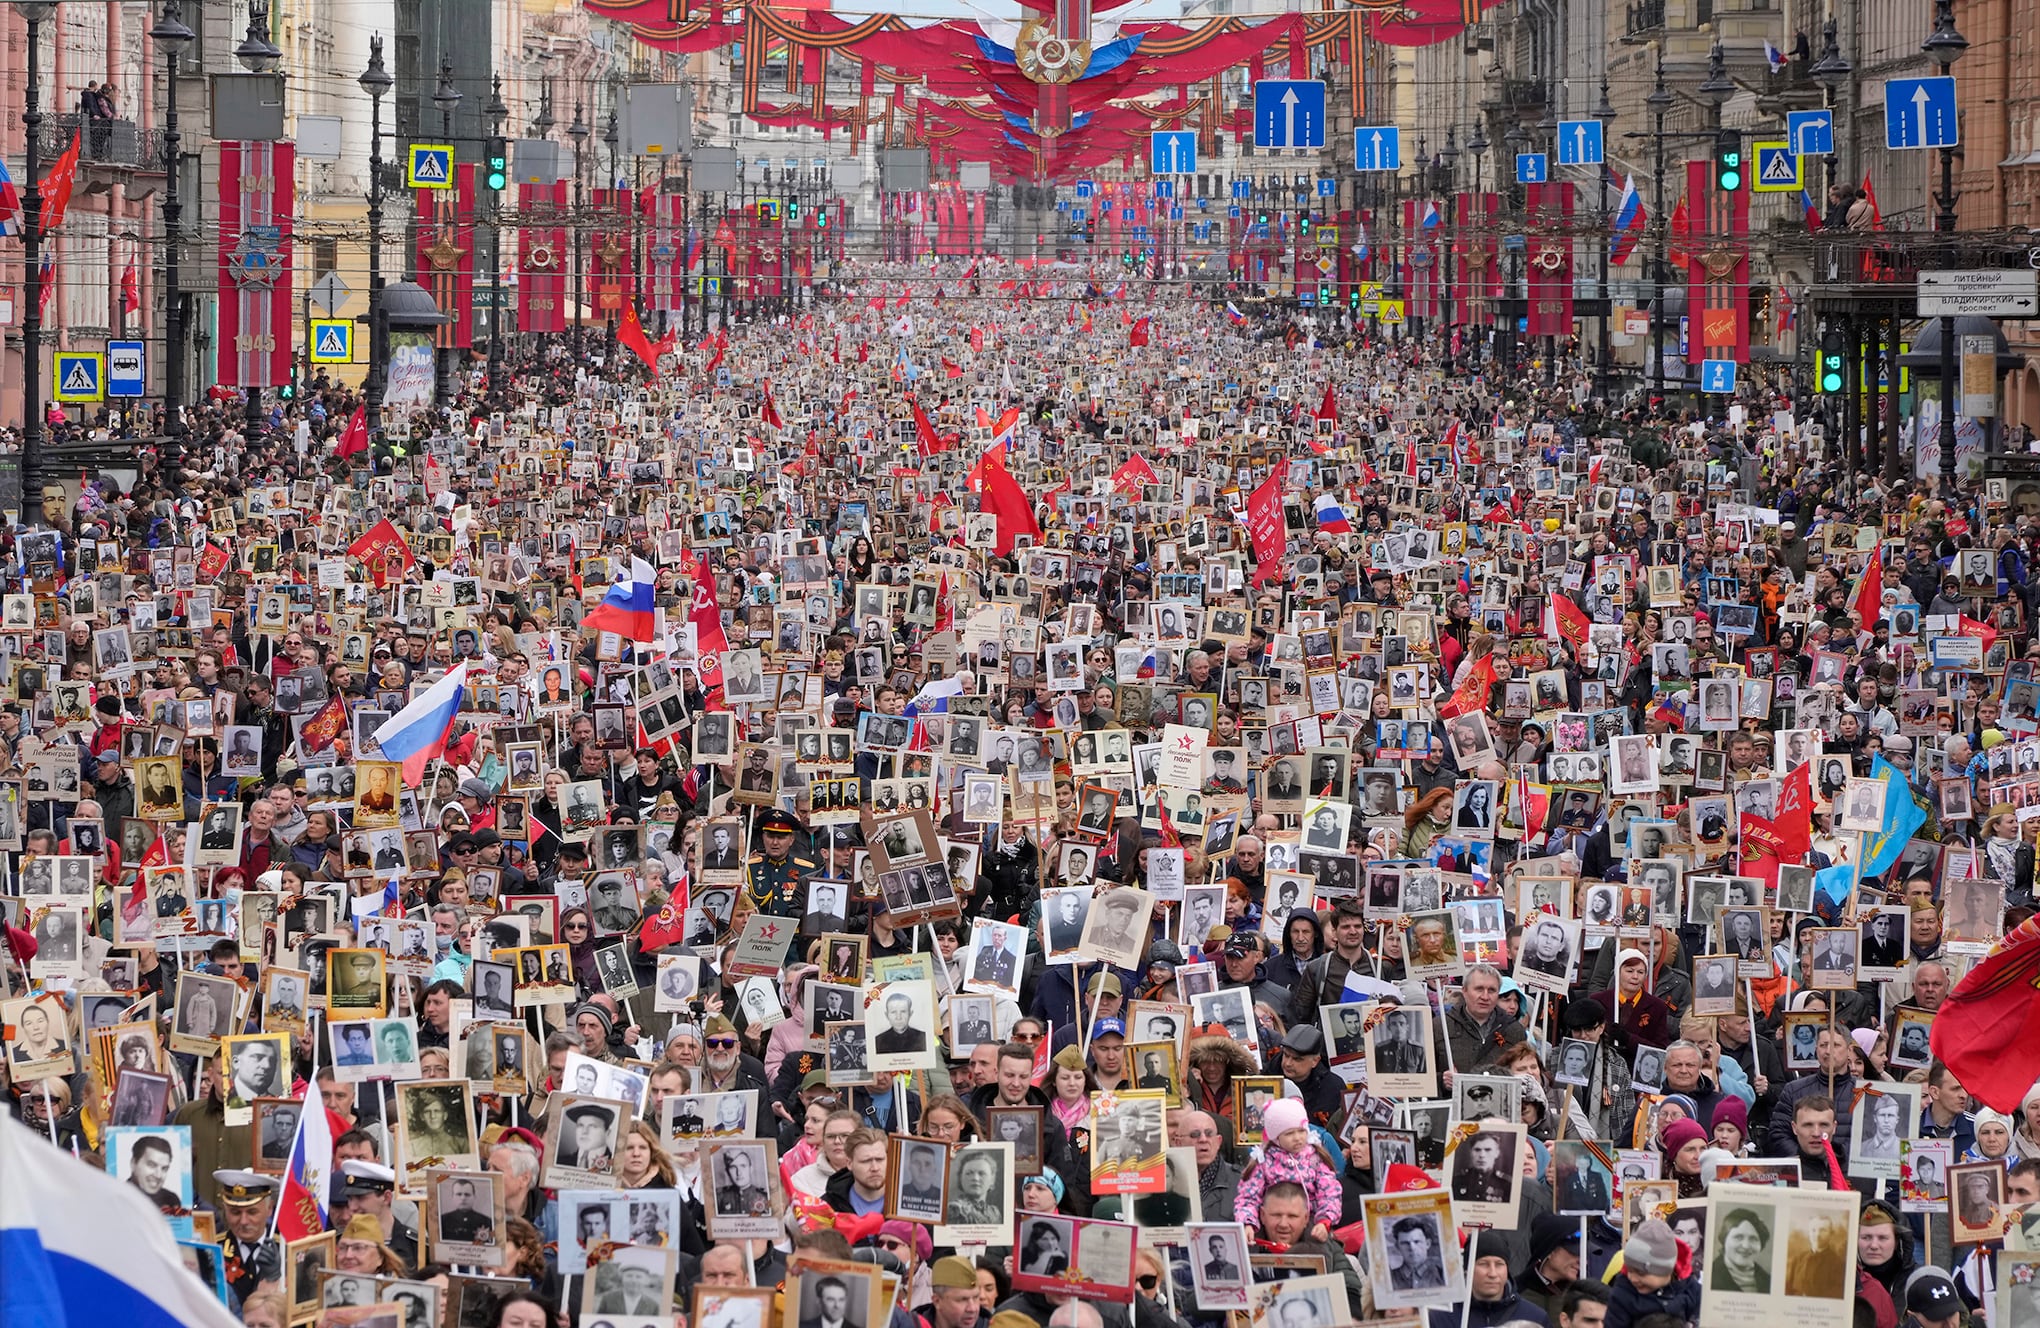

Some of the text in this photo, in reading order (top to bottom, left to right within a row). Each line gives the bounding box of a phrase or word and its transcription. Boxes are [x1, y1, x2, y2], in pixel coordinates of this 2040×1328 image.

[490, 158, 503, 170] 49
[1724, 153, 1738, 167] 49
[237, 176, 276, 194] 1941
[1954, 273, 2002, 282] ЛИТЕЙНЫЙ
[528, 299, 554, 311] 1945
[1942, 295, 2014, 304] ВЛАДИМИРСКИЙ
[1537, 302, 1563, 314] 1945
[234, 334, 276, 353] 1945
[396, 346, 409, 366] 9
[1826, 356, 1840, 368] 49
[1922, 399, 1936, 427] 9
[33, 749, 76, 758] Ленинграда
[1742, 822, 1753, 834] 9
[752, 944, 772, 952] полк
